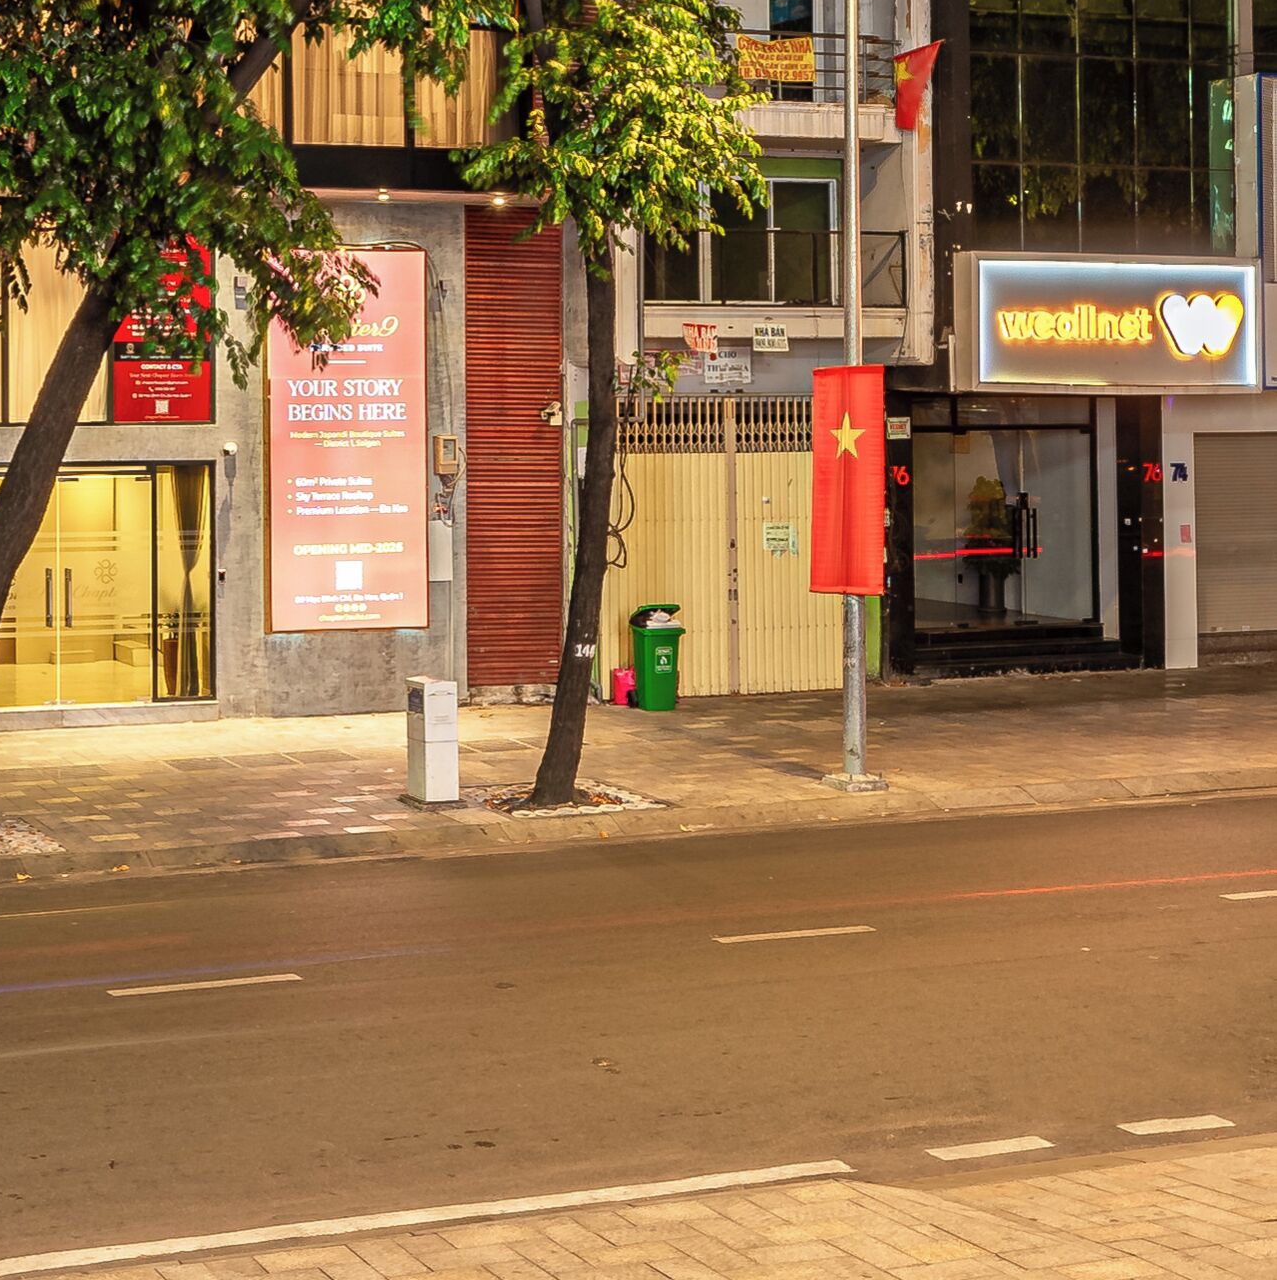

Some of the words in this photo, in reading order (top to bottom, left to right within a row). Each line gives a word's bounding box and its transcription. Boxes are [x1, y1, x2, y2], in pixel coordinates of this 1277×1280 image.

[287, 379, 339, 397] YOUR
[343, 379, 404, 397] STORY
[288, 403, 353, 421] BEGINS
[358, 402, 407, 420] HERE
[1143, 463, 1163, 482] 76
[1170, 462, 1189, 482] 74
[293, 543, 348, 556] OPENING
